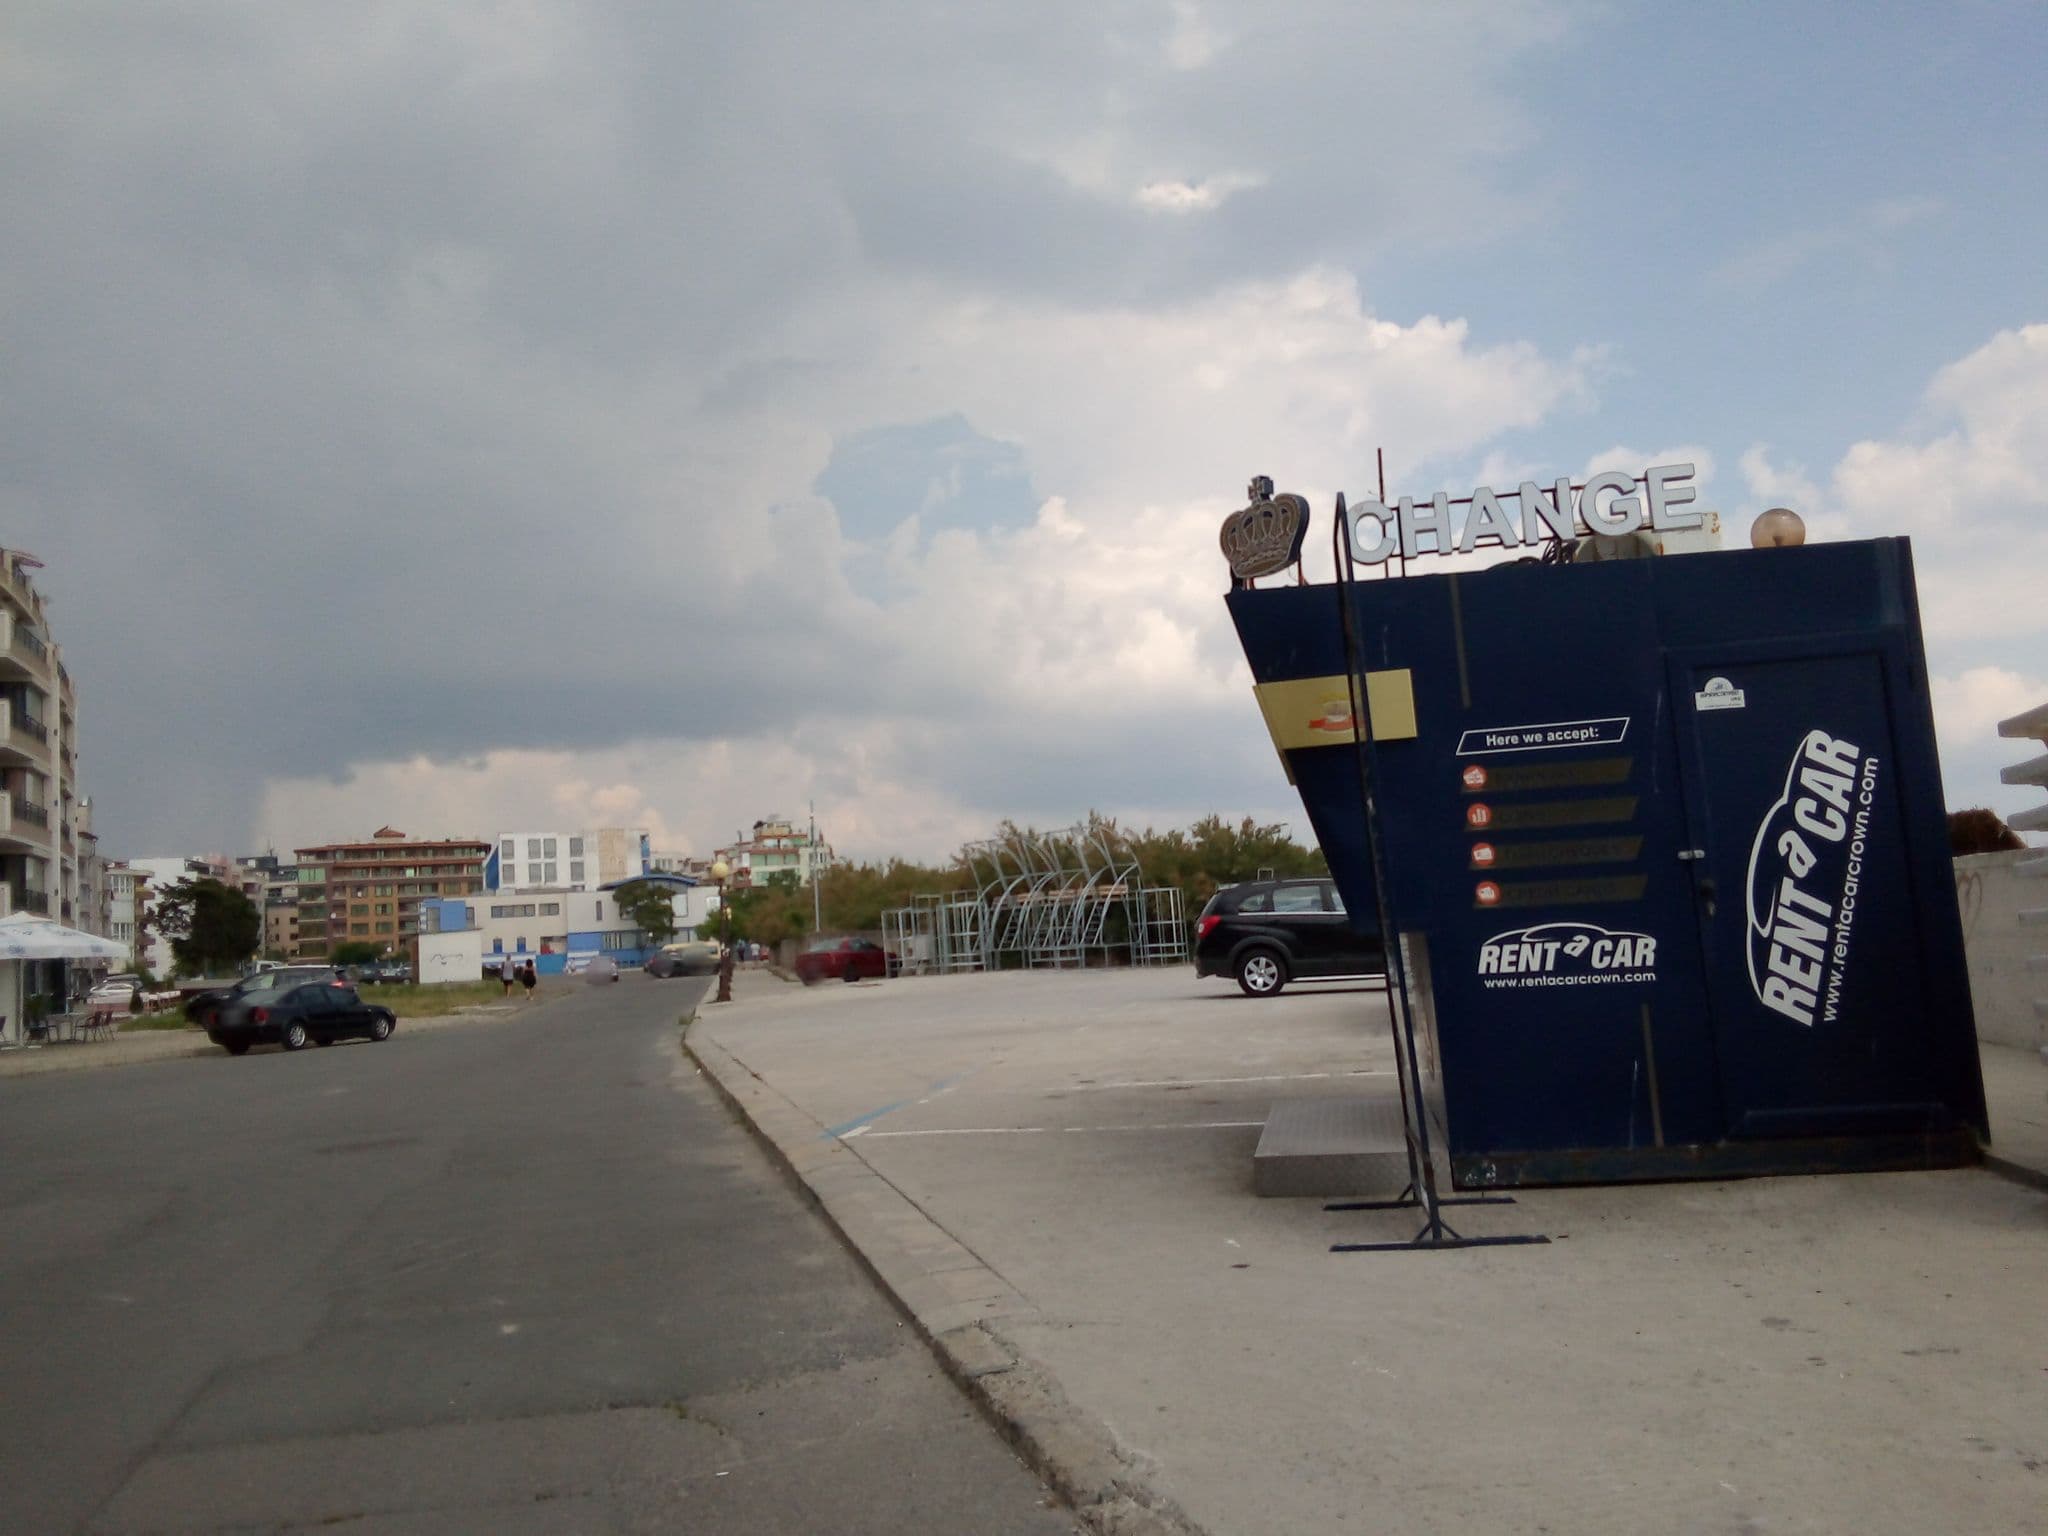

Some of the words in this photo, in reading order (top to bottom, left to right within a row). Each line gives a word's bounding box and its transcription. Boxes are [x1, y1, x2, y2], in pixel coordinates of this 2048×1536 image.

[1346, 463, 1703, 565] CHANGE
[1486, 734, 1519, 747] Here
[1522, 733, 1543, 743] we
[1547, 727, 1599, 742] accept:
[1794, 730, 1859, 841] CAR
[1778, 830, 1817, 878] a
[1824, 757, 1879, 1021] www.rentacarcrown.com
[1478, 941, 1561, 975] RENT
[1563, 934, 1590, 958] a
[1591, 936, 1657, 969] CAR
[1484, 972, 1656, 988] www.rentacarcrown.com
[1761, 876, 1832, 1027] RENT
